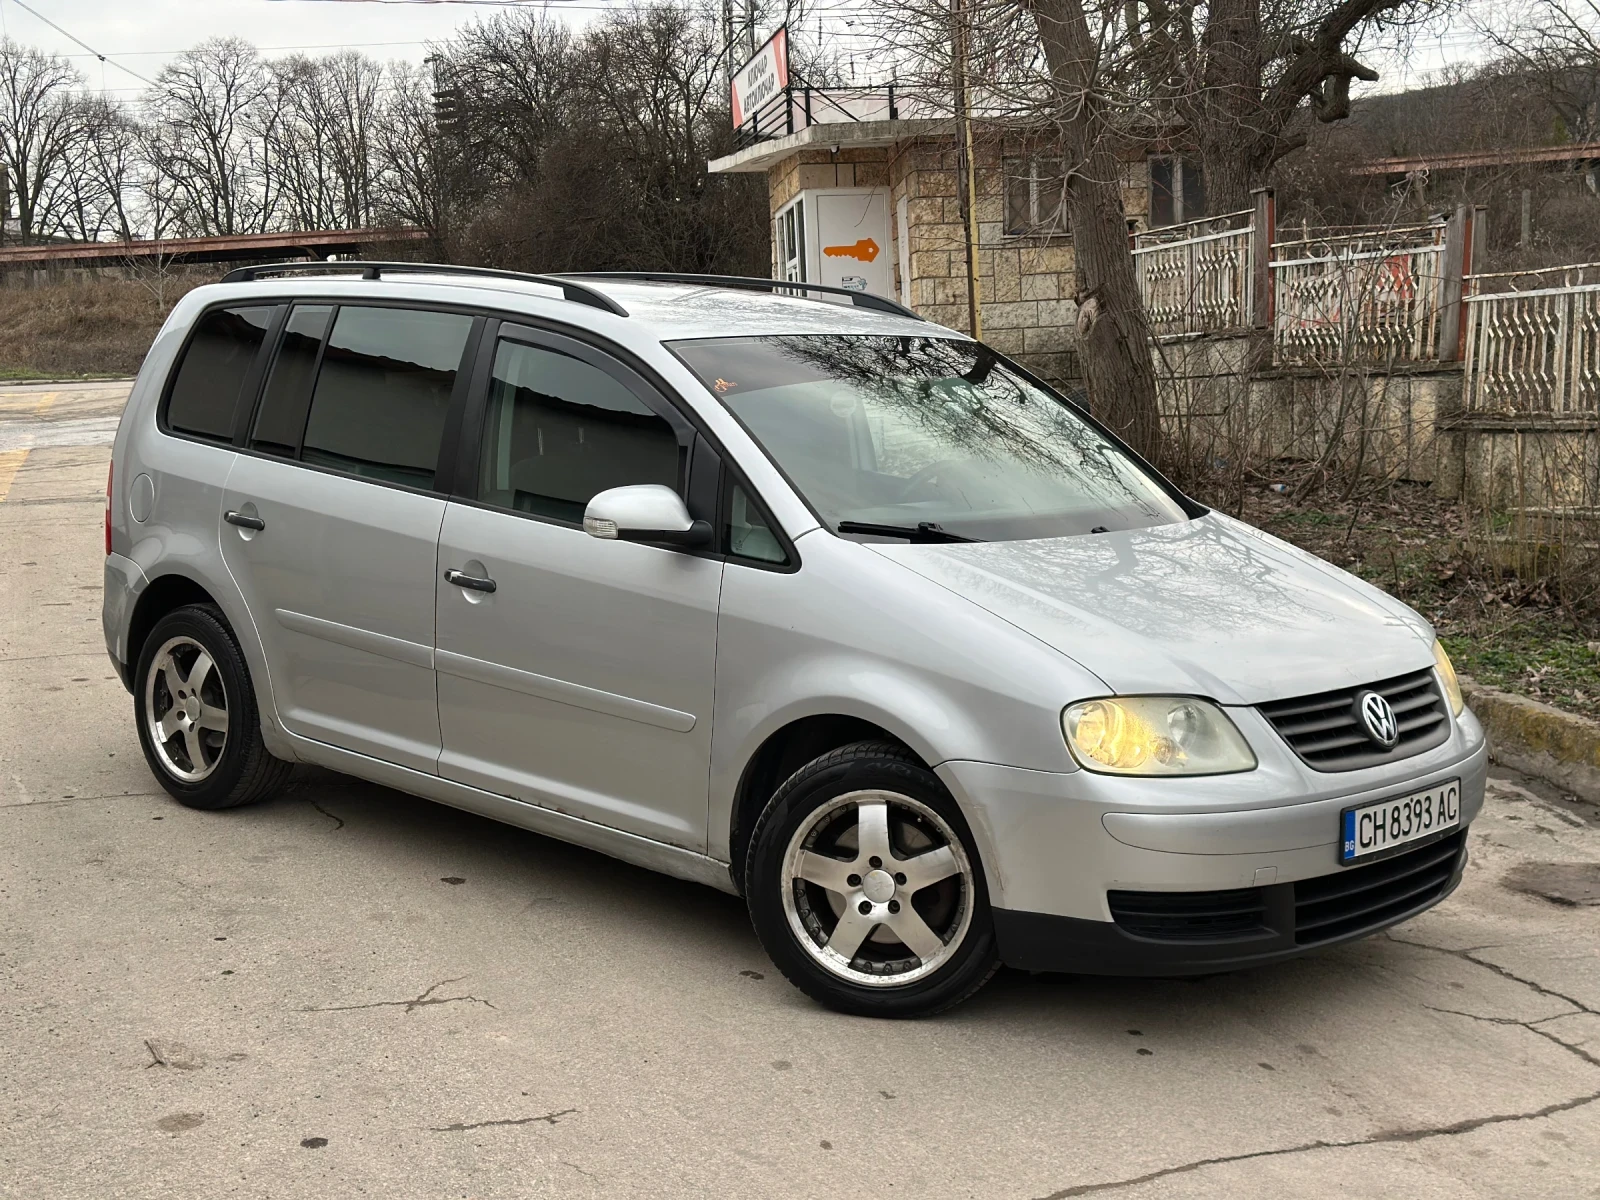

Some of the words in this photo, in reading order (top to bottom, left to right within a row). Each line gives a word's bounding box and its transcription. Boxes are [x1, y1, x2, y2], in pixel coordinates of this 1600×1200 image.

[748, 54, 768, 89] КЛЮЧАР
[1390, 796, 1432, 840] 8393
[1344, 840, 1355, 852] BG
